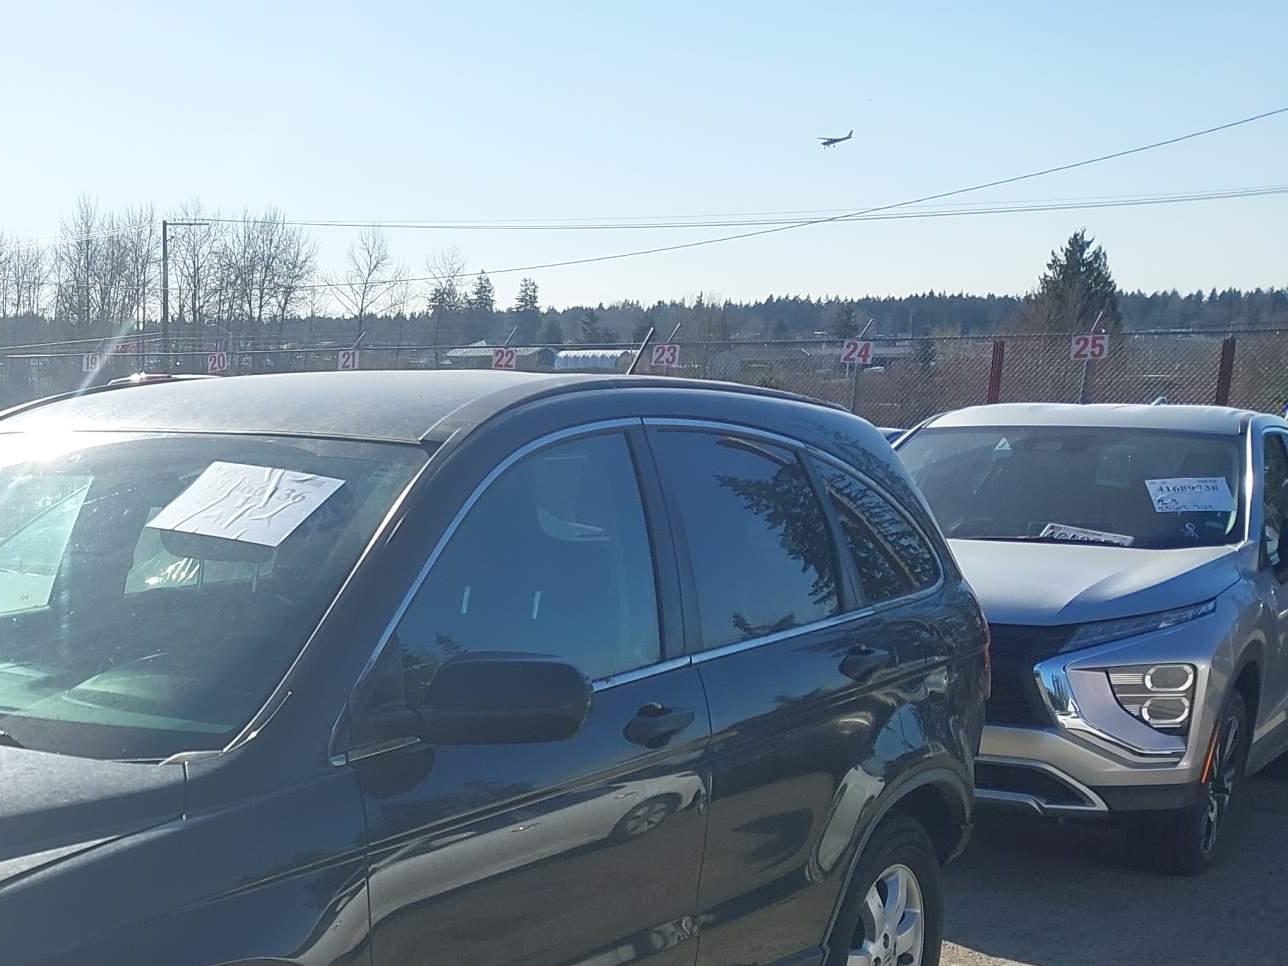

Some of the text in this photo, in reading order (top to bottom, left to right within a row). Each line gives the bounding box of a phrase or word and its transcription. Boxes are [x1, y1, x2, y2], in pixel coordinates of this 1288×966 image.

[655, 346, 678, 365] 23
[843, 342, 871, 363] 24
[1074, 337, 1106, 359] 25
[84, 354, 97, 370] 19
[210, 353, 226, 370] 20
[341, 352, 356, 368] 21
[494, 349, 515, 368] 22
